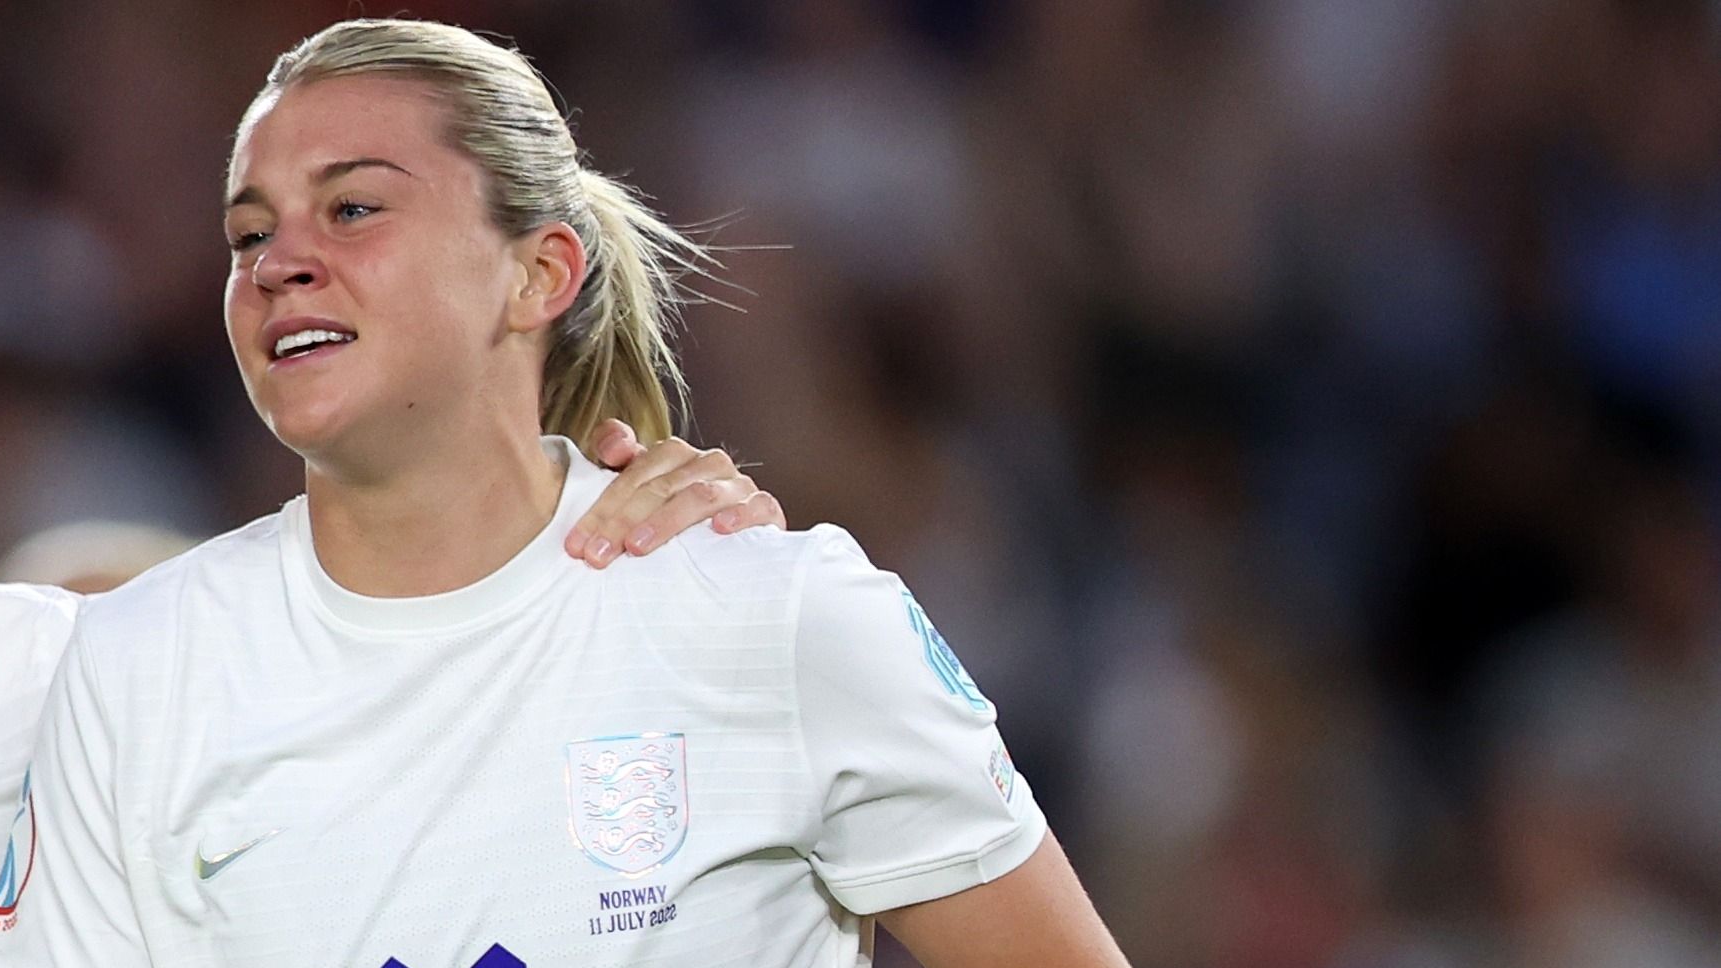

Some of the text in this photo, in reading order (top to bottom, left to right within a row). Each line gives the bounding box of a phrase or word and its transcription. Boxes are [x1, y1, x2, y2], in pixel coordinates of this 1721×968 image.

[600, 885, 667, 910] NORWAY
[607, 910, 645, 933] JULY
[650, 903, 677, 927] 2022
